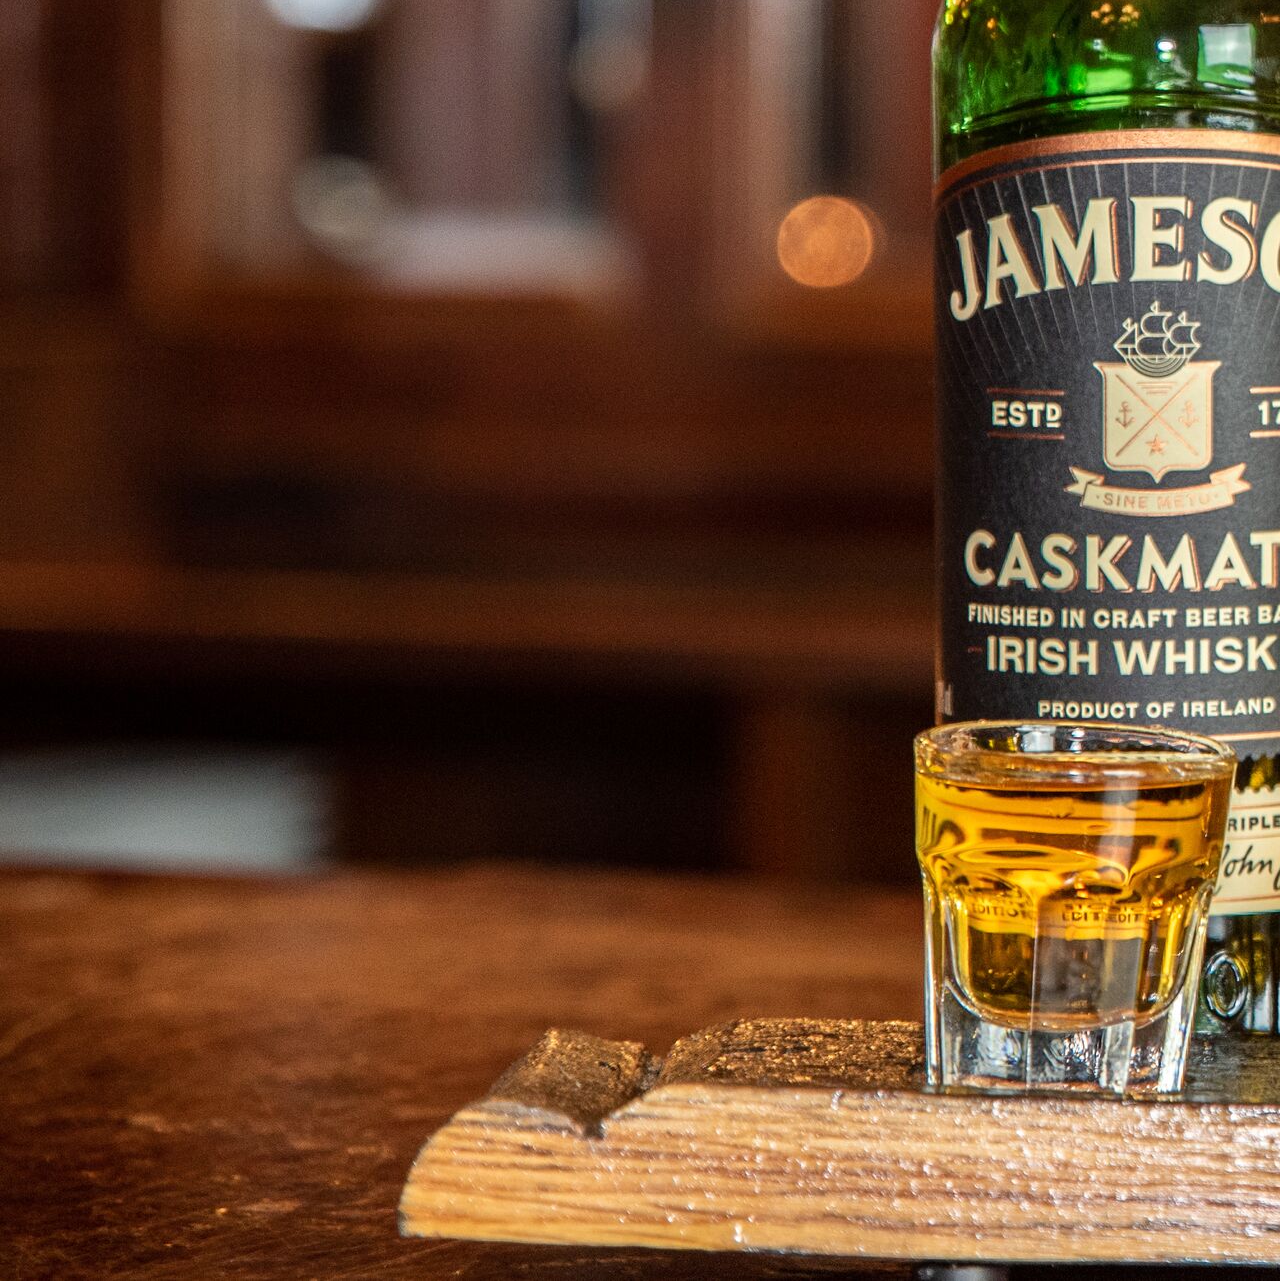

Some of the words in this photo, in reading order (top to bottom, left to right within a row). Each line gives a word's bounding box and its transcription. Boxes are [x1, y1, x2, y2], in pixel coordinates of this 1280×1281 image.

[992, 401, 1062, 429] ESTD
[1103, 492, 1147, 510] SINE
[967, 602, 1053, 628] FINISHED
[1060, 607, 1086, 629] IN
[1094, 607, 1177, 629] CRAFT
[1185, 605, 1250, 629] BEER
[986, 635, 1098, 677] IRISH
[1038, 698, 1139, 719] PRODUCT
[1146, 700, 1174, 719] OF
[1182, 696, 1277, 718] IRELAND
[1228, 814, 1280, 832] RIPLE
